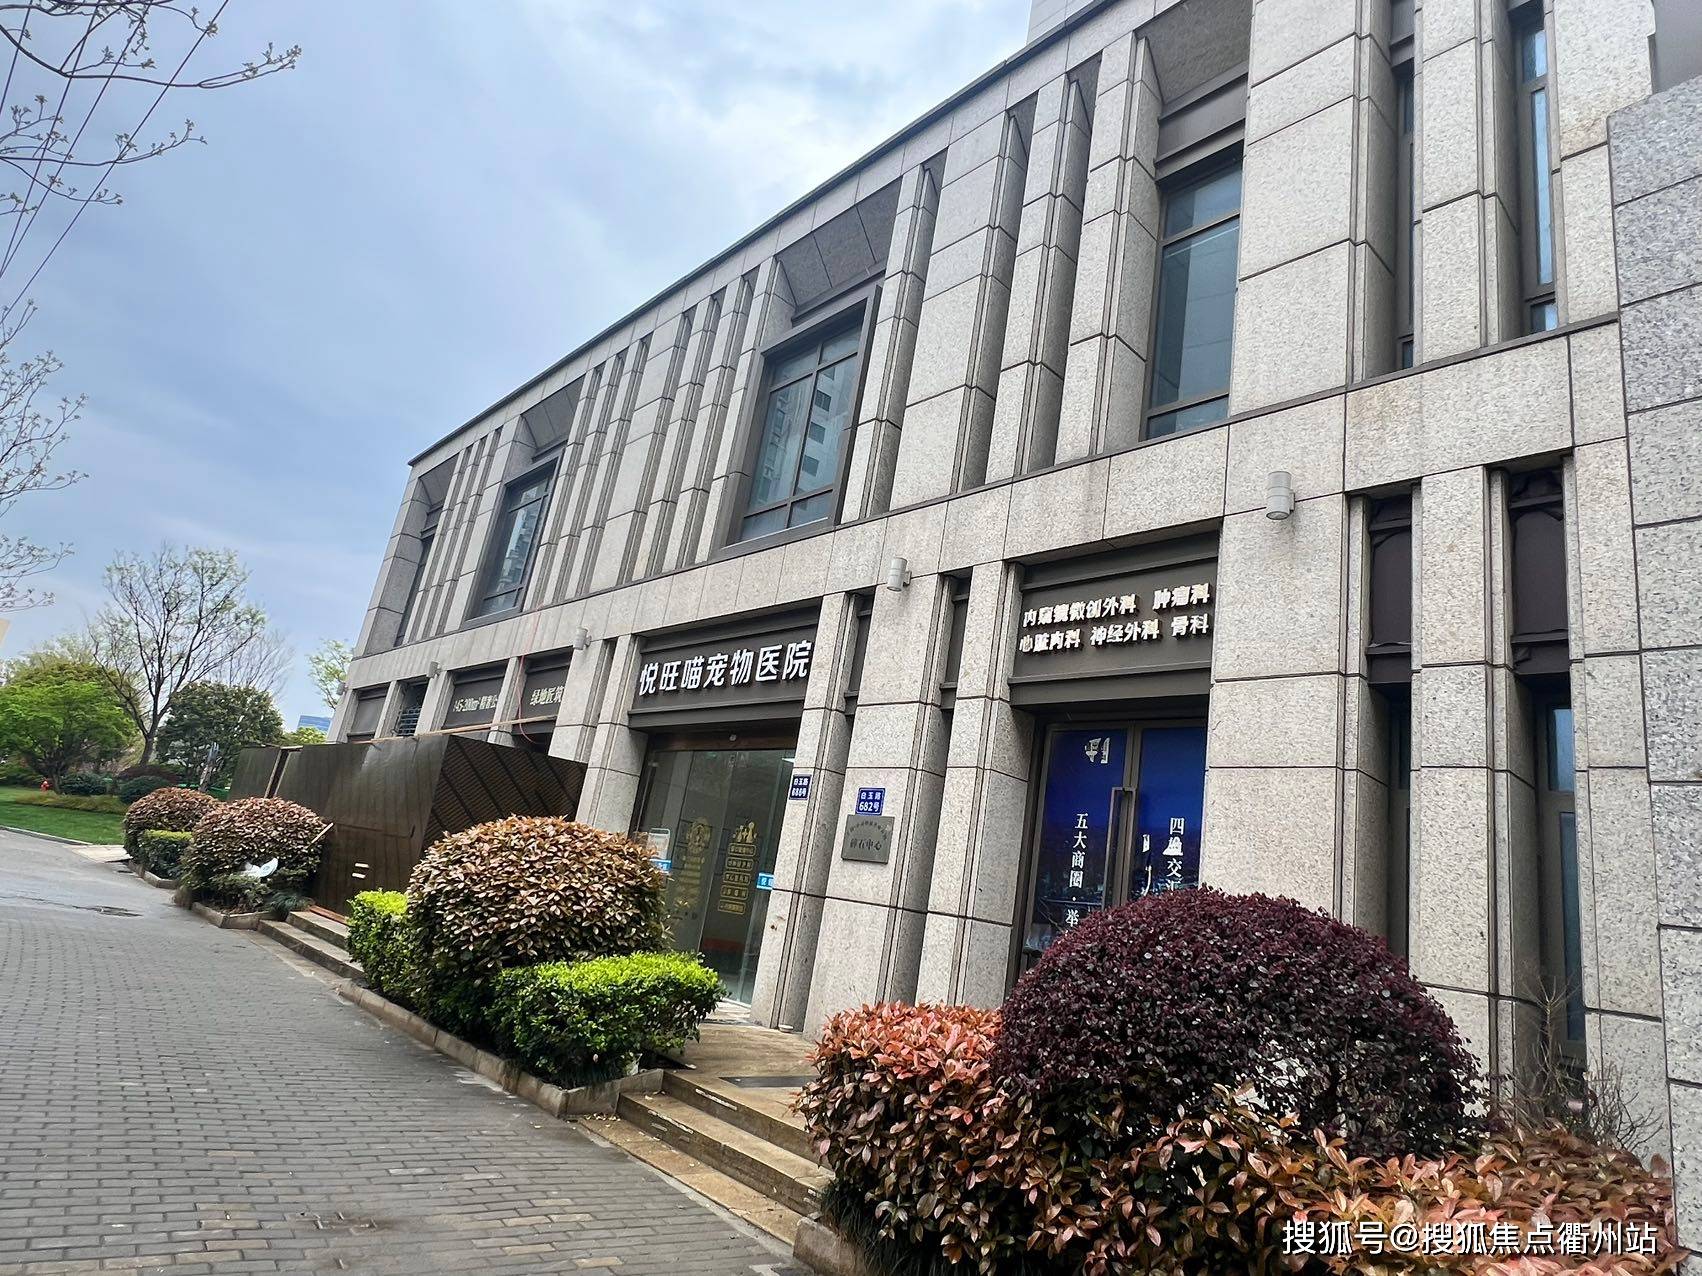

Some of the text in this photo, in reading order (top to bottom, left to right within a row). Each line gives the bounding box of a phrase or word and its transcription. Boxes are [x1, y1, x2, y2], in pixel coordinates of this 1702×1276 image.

[1022, 582, 1210, 628] 内窥镜微创外科 肿瘤科
[1019, 613, 1210, 653] 心脏内科 神经外科 骨科
[638, 639, 813, 696] 悦旺喵宠物医院
[859, 801, 880, 812] 682号
[860, 791, 881, 800] 白玉路
